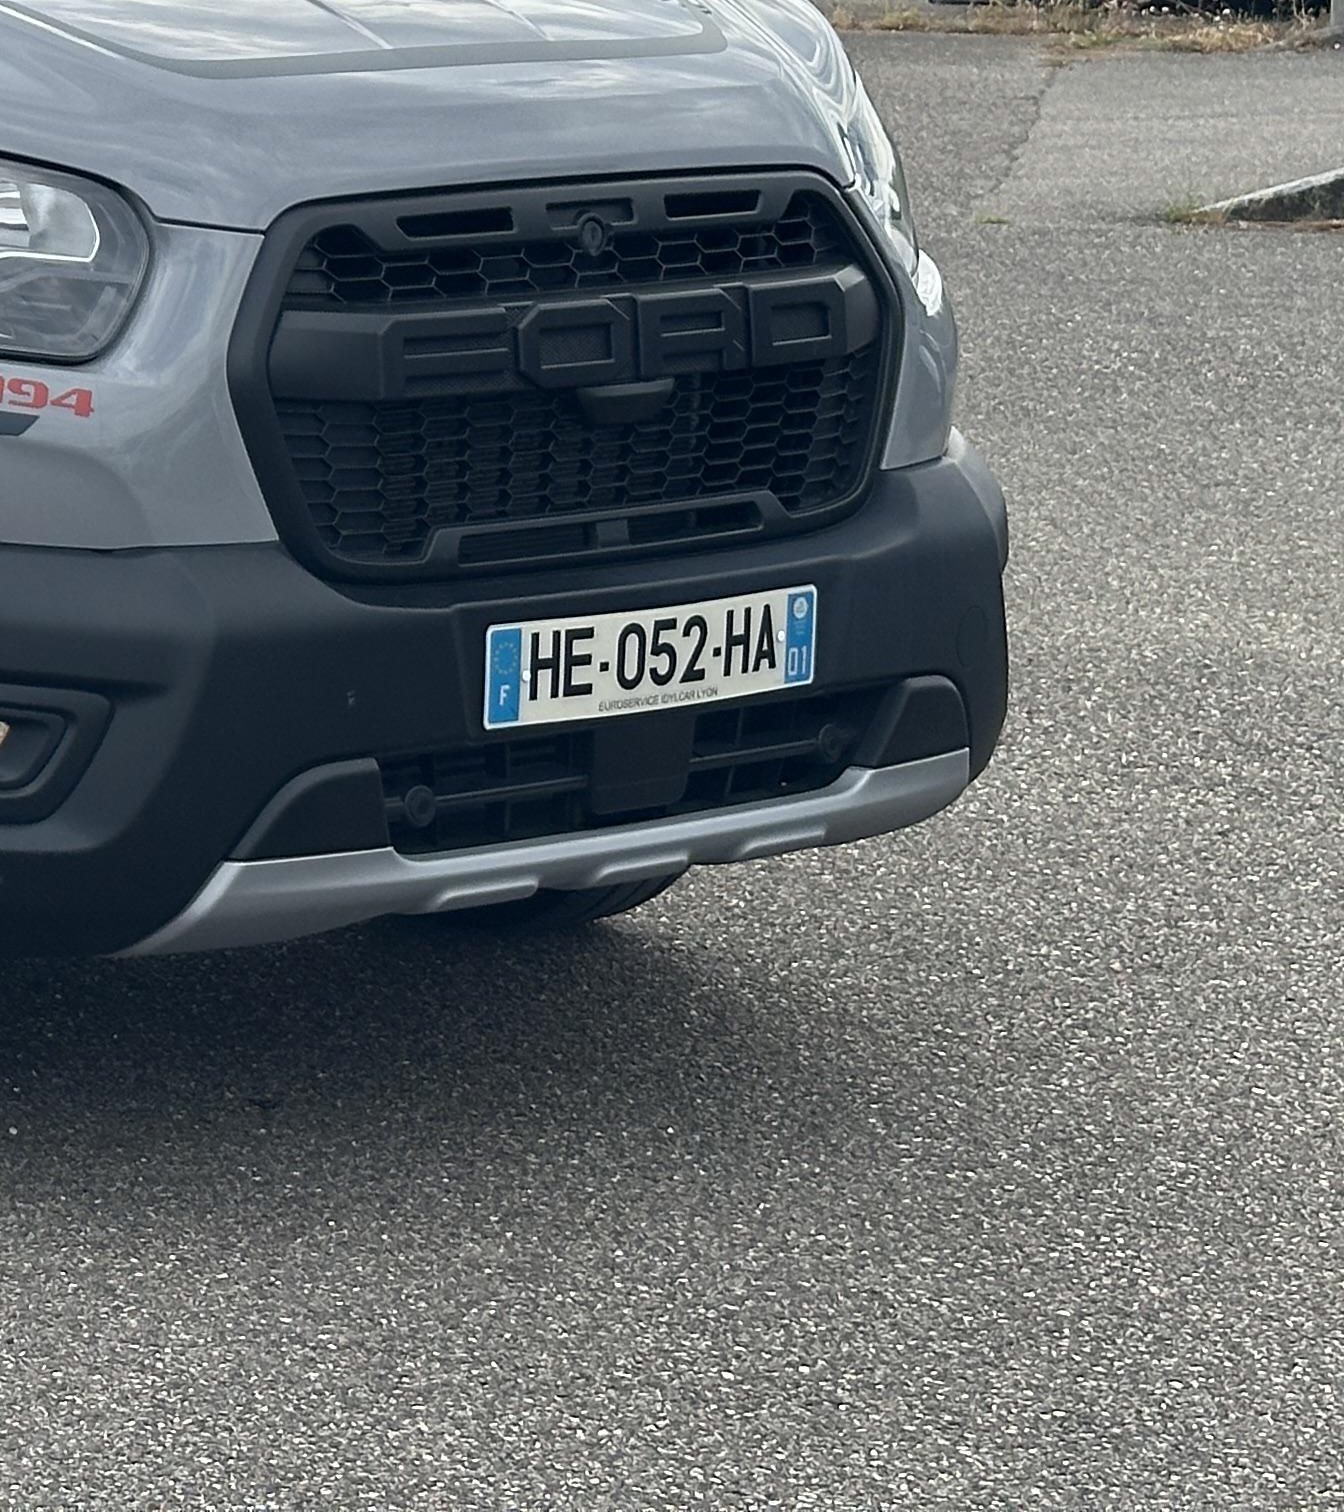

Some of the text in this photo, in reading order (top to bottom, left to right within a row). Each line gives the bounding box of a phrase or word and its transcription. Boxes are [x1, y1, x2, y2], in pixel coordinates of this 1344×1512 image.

[499, 603, 808, 707] F HE-052-HA 01
